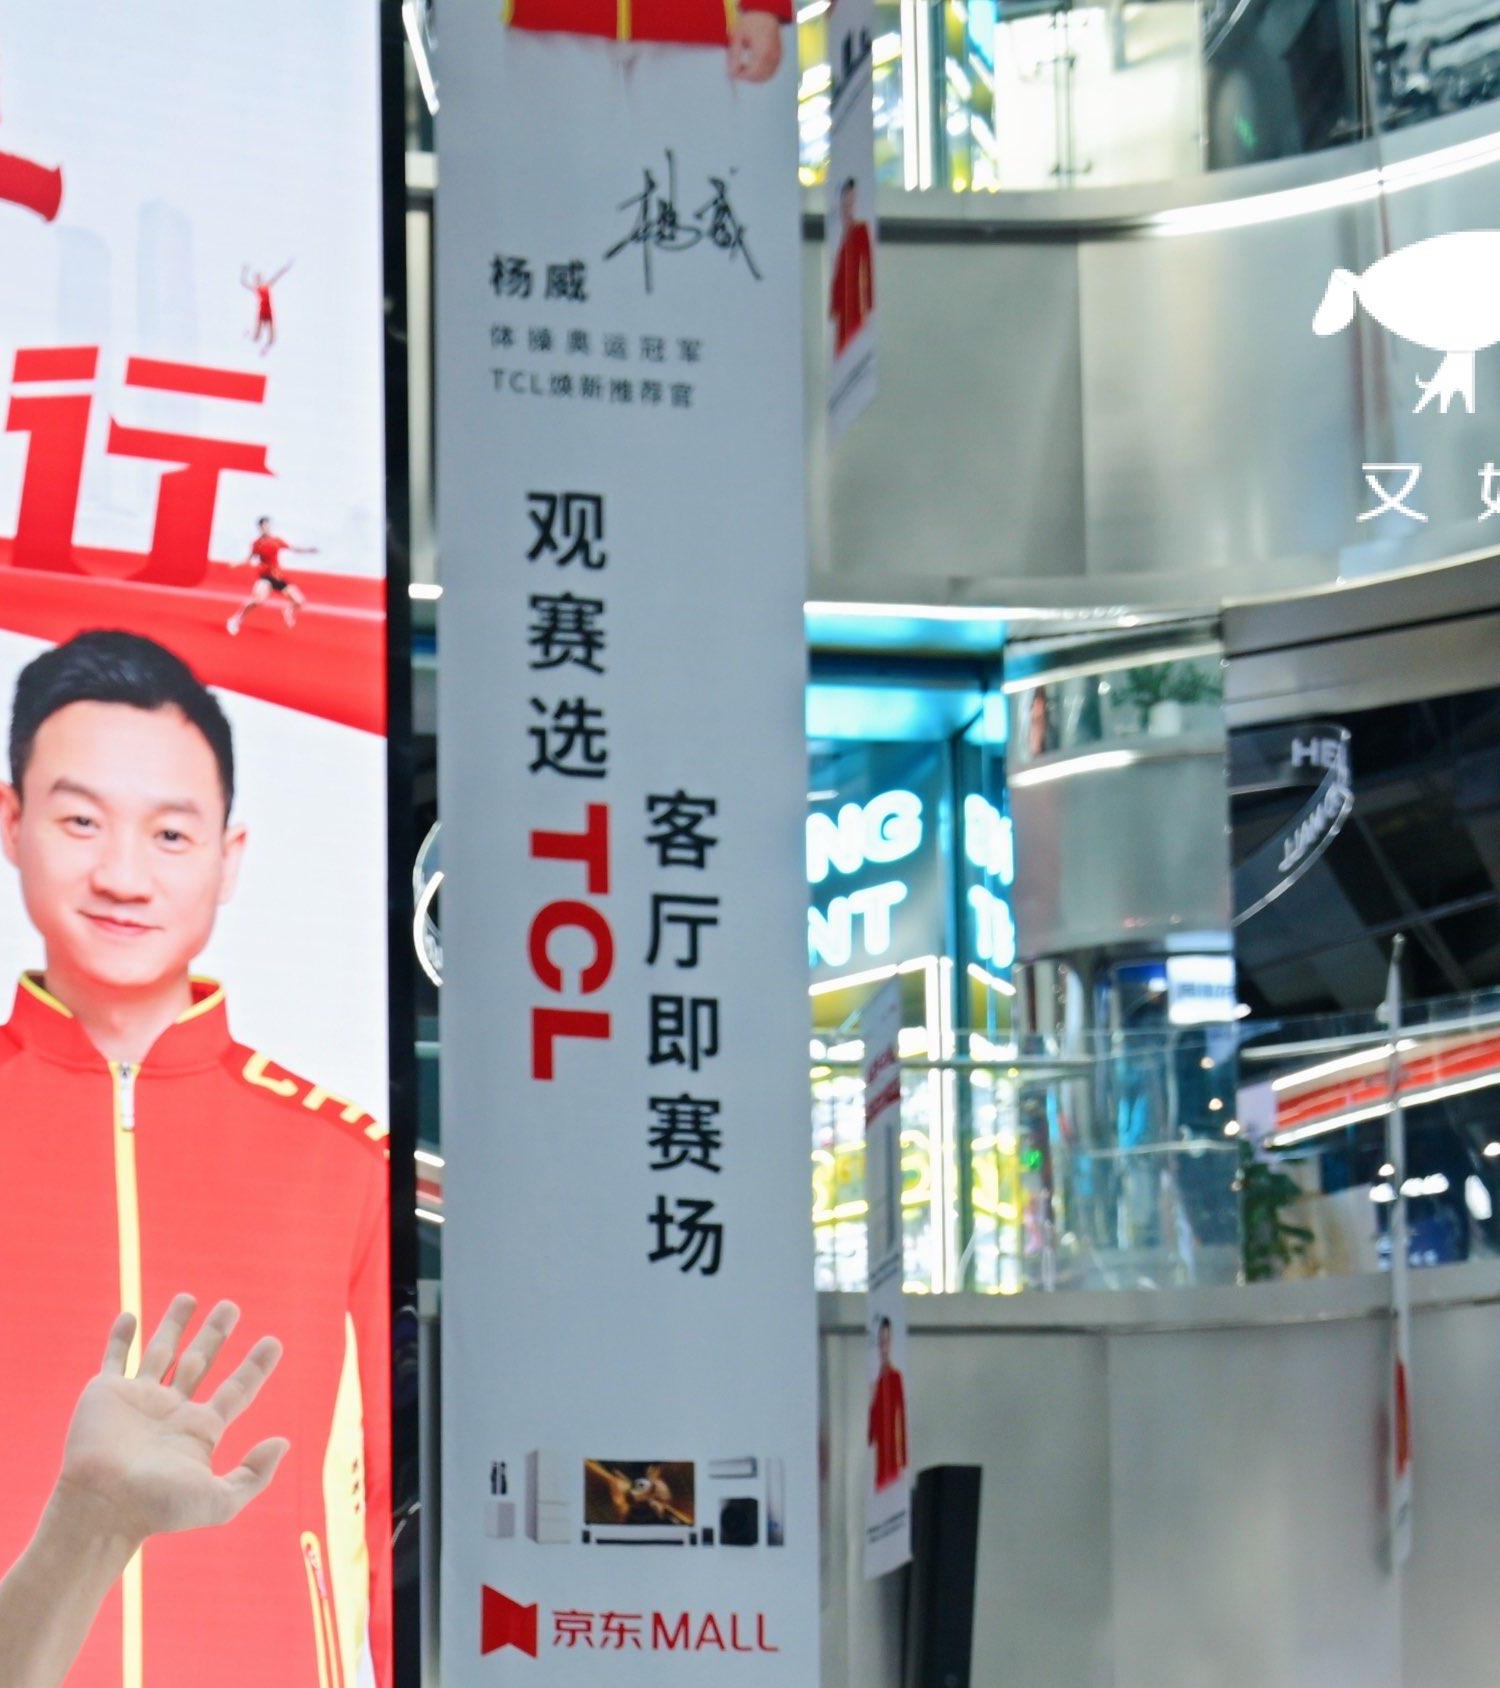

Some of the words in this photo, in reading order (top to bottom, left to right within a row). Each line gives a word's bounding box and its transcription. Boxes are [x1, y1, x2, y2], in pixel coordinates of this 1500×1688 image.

[489, 252, 589, 302] 杨威
[489, 323, 705, 364] 体操奥运冠军
[490, 368, 697, 409] TCL焕新推荐官
[644, 790, 726, 1277] 客厅即赛场
[552, 1608, 780, 1653] 京东MALL
